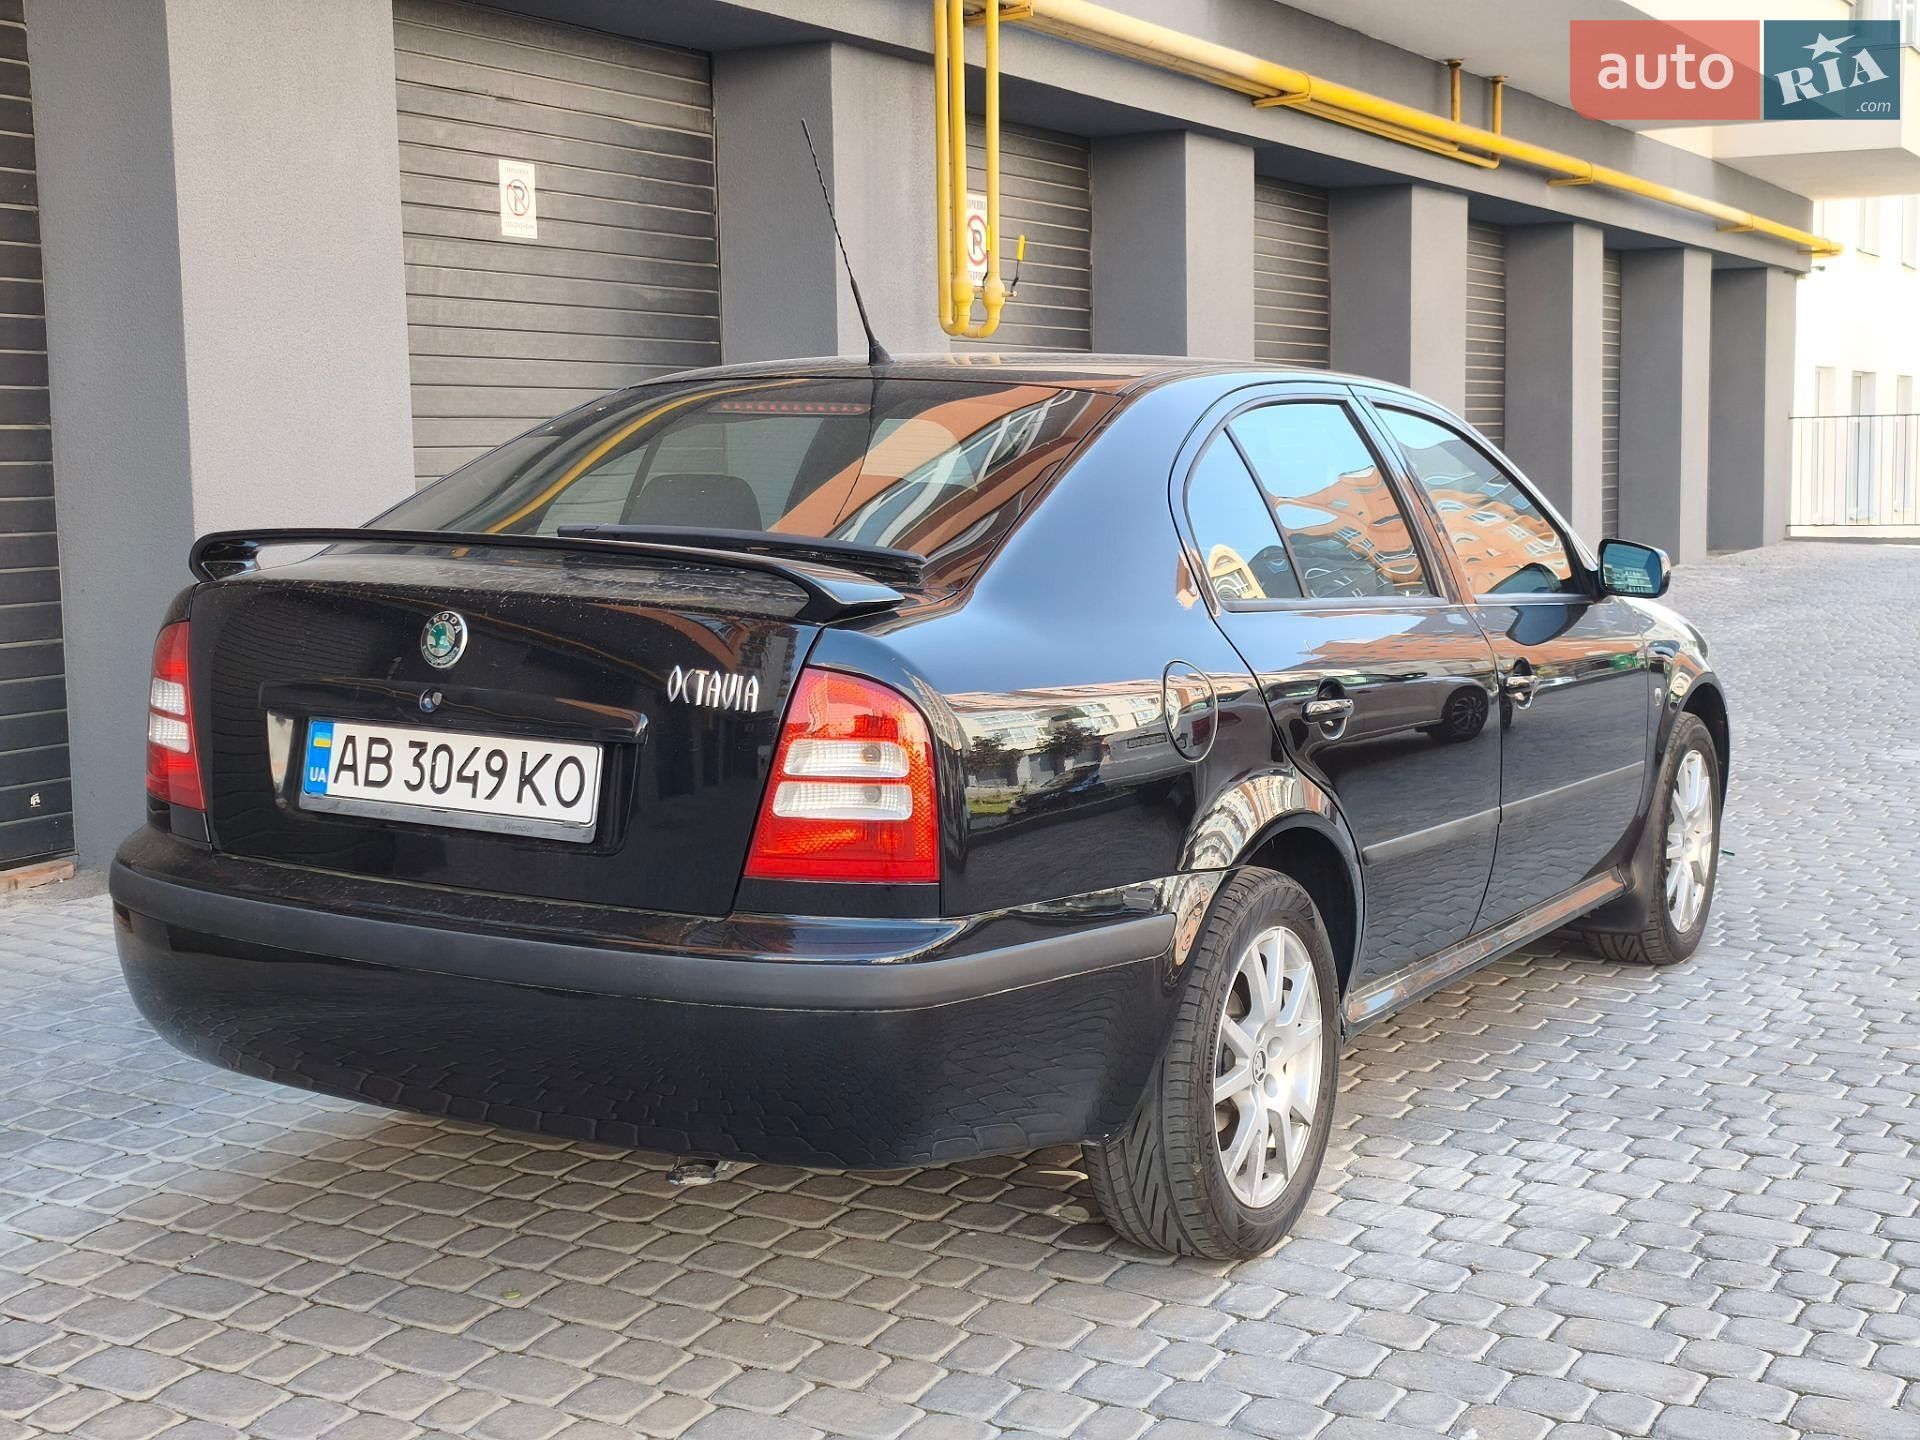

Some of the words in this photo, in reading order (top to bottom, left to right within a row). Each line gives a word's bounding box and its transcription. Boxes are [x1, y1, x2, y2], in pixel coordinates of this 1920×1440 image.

[667, 664, 760, 713] OCTAVIA
[308, 766, 327, 783] UA
[333, 735, 394, 789] AB
[403, 740, 509, 801] 3049
[516, 751, 586, 809] KO
